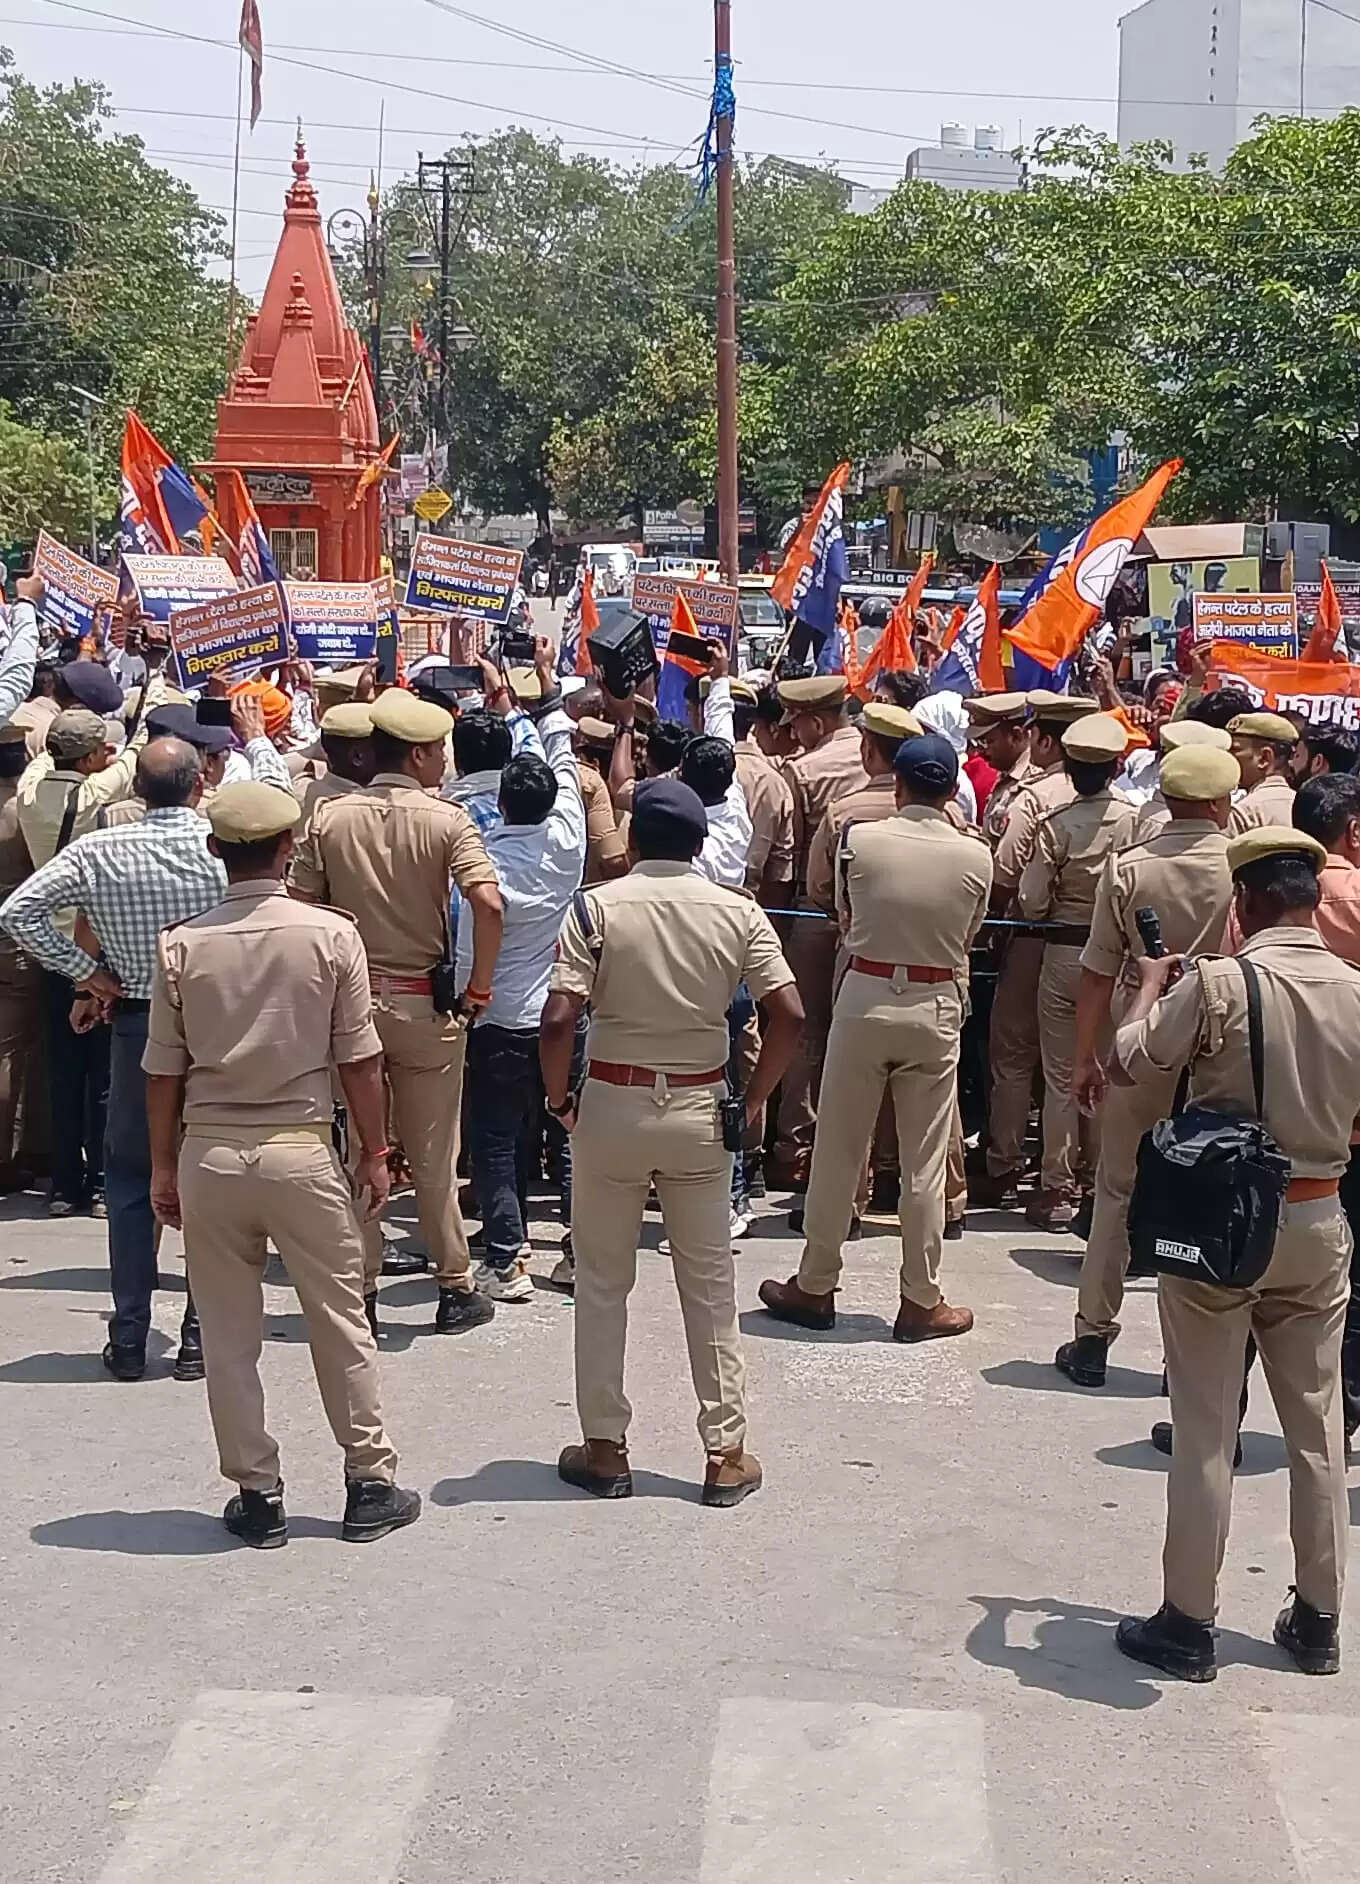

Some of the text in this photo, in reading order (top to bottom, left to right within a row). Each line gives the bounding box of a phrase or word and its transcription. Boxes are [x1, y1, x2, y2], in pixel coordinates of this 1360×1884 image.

[450, 545, 471, 559] पटेल
[472, 550, 483, 560] के
[873, 573, 914, 584] BIG BO
[416, 580, 476, 606] गिरफ्तार
[638, 579, 660, 593] पटेल
[692, 587, 708, 600] की
[1334, 584, 1360, 594] DAAN
[1224, 600, 1249, 615] पटेल
[1249, 599, 1263, 615] के
[1264, 602, 1291, 617] हत्या
[1224, 623, 1256, 637] भाजपा
[1257, 620, 1278, 637] नेता
[1280, 620, 1292, 637] के
[186, 648, 247, 676] गिरफ्तार
[1155, 1241, 1200, 1263] AHUJA
